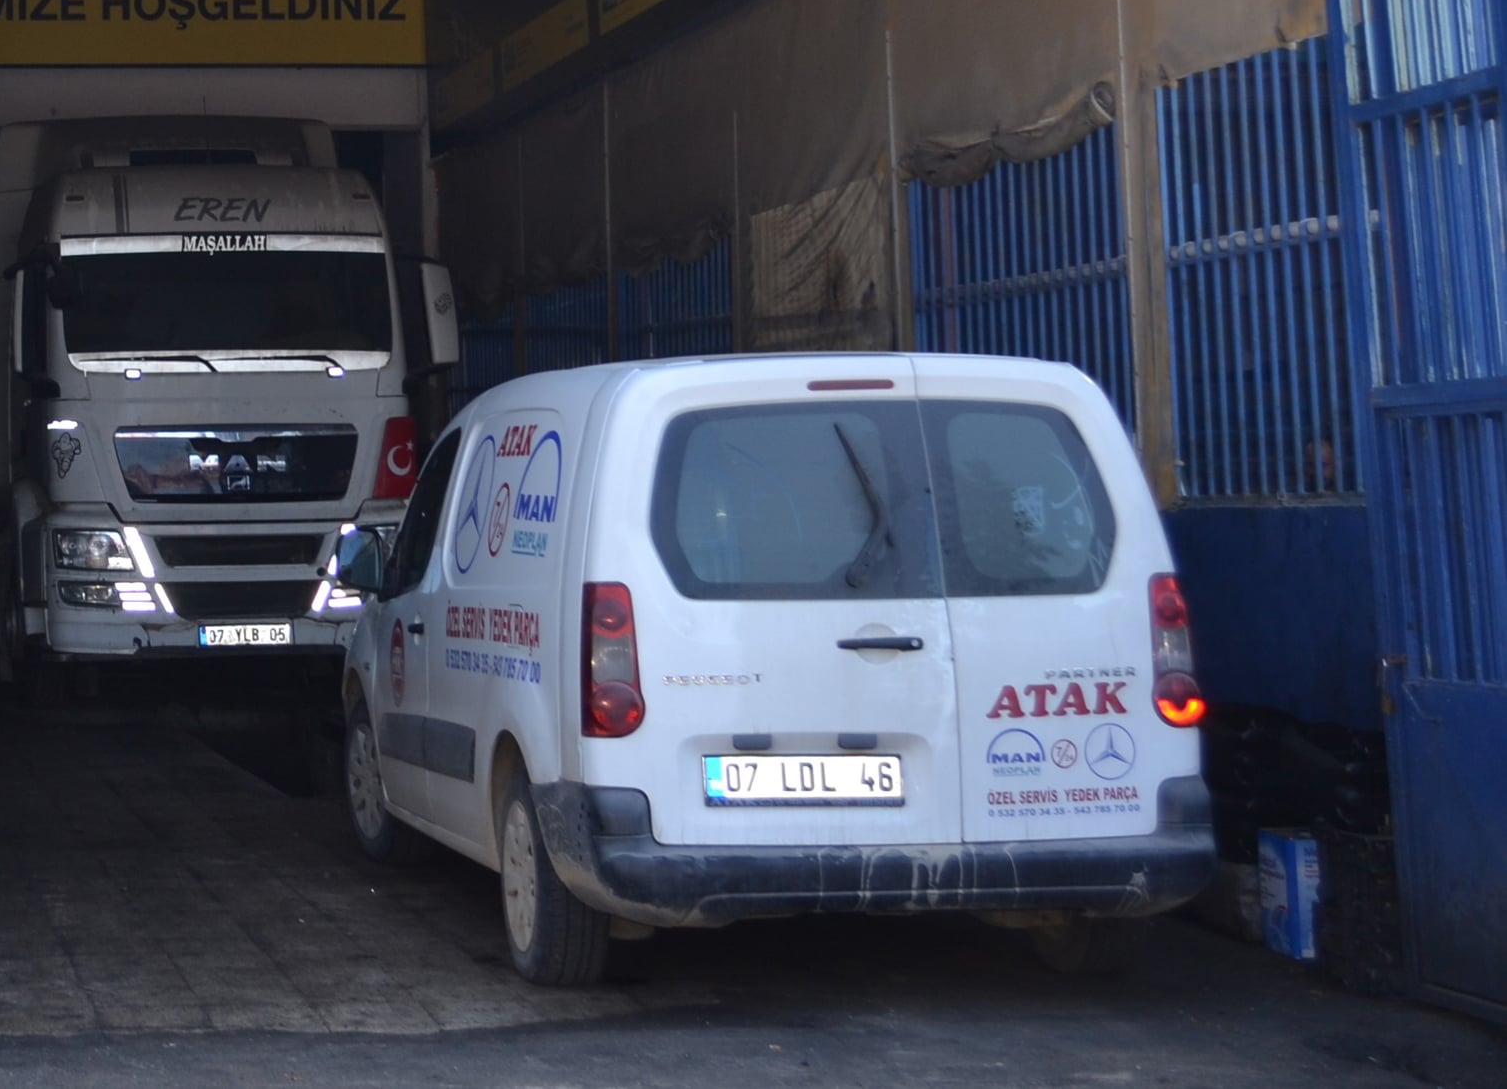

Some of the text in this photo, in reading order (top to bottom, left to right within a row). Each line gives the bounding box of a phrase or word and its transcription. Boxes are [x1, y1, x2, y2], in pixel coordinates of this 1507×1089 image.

[174, 197, 270, 223] EREN
[183, 235, 267, 255] MAŞALLAH
[496, 423, 538, 457] ATAK
[189, 454, 287, 473] MAN
[516, 494, 556, 523] MAN
[234, 628, 260, 642] YLB
[269, 627, 286, 642] 05
[488, 607, 514, 644] YEDEK
[514, 611, 541, 657] PARÇA
[529, 660, 541, 684] 00
[1044, 666, 1137, 680] PARTNER
[986, 681, 1128, 719] ATAK
[992, 752, 1041, 764] MAN
[726, 762, 893, 792] 07 LDL 46
[988, 785, 1139, 805] ÖZEL SERVİS YEDEK PARÇA
[1039, 807, 1050, 816] 34
[1128, 803, 1140, 813] 00
